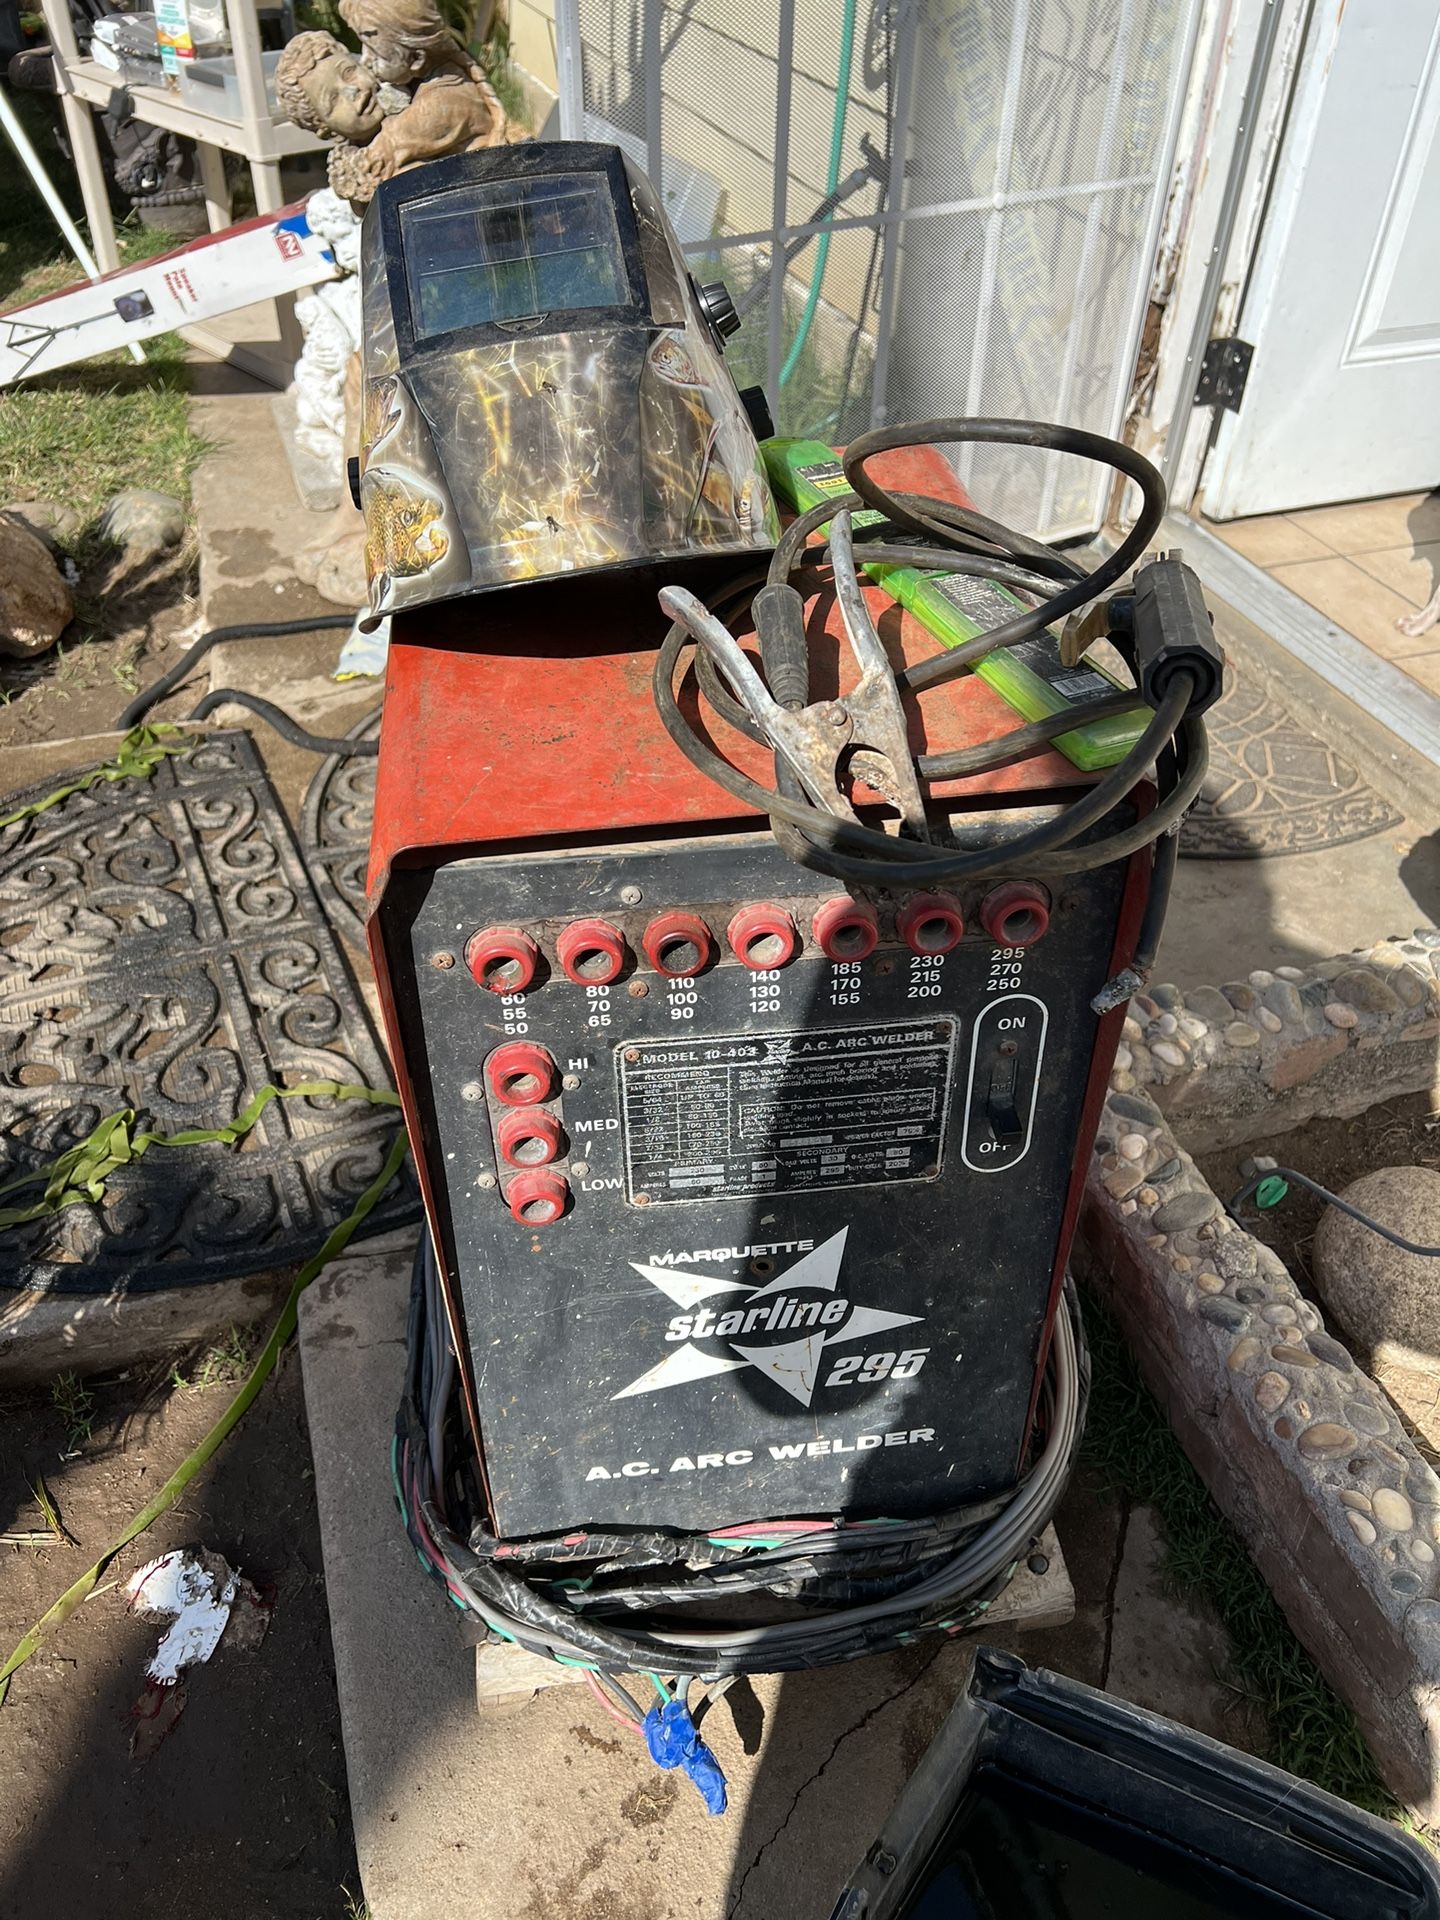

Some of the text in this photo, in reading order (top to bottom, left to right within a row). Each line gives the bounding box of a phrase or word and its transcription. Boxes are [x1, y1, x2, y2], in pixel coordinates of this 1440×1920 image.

[991, 947, 1025, 961] 295
[831, 961, 862, 975] 185
[910, 955, 945, 968] 230
[749, 969, 781, 983] 140
[990, 962, 1023, 976] 270
[668, 977, 695, 990] 110
[910, 970, 941, 983] 215
[830, 977, 861, 991] 170
[986, 977, 1021, 991] 250
[586, 985, 610, 998] 80
[666, 991, 698, 1005] 100
[749, 985, 781, 998] 130
[907, 985, 942, 998] 200
[829, 992, 861, 1006] 155
[588, 1000, 611, 1013] 70
[670, 1007, 694, 1020] 90
[749, 1000, 781, 1013] 120
[502, 1008, 527, 1021] 55
[588, 1015, 612, 1027] 65
[504, 1022, 529, 1035] 50
[997, 1016, 1027, 1031] ON
[802, 1031, 934, 1052] A.C. ARC WELDER
[568, 1057, 589, 1071] HI
[642, 1051, 699, 1065] MODEL
[575, 1118, 619, 1132] MED
[797, 1146, 849, 1157] SECONDARY
[674, 1157, 714, 1167] PRIMARY
[581, 1177, 624, 1192] LOW
[650, 1239, 815, 1267] MARQUETTE
[664, 1296, 850, 1342] starline
[823, 1347, 931, 1388] 295
[584, 1427, 936, 1483] A.C. ARC WELDER
